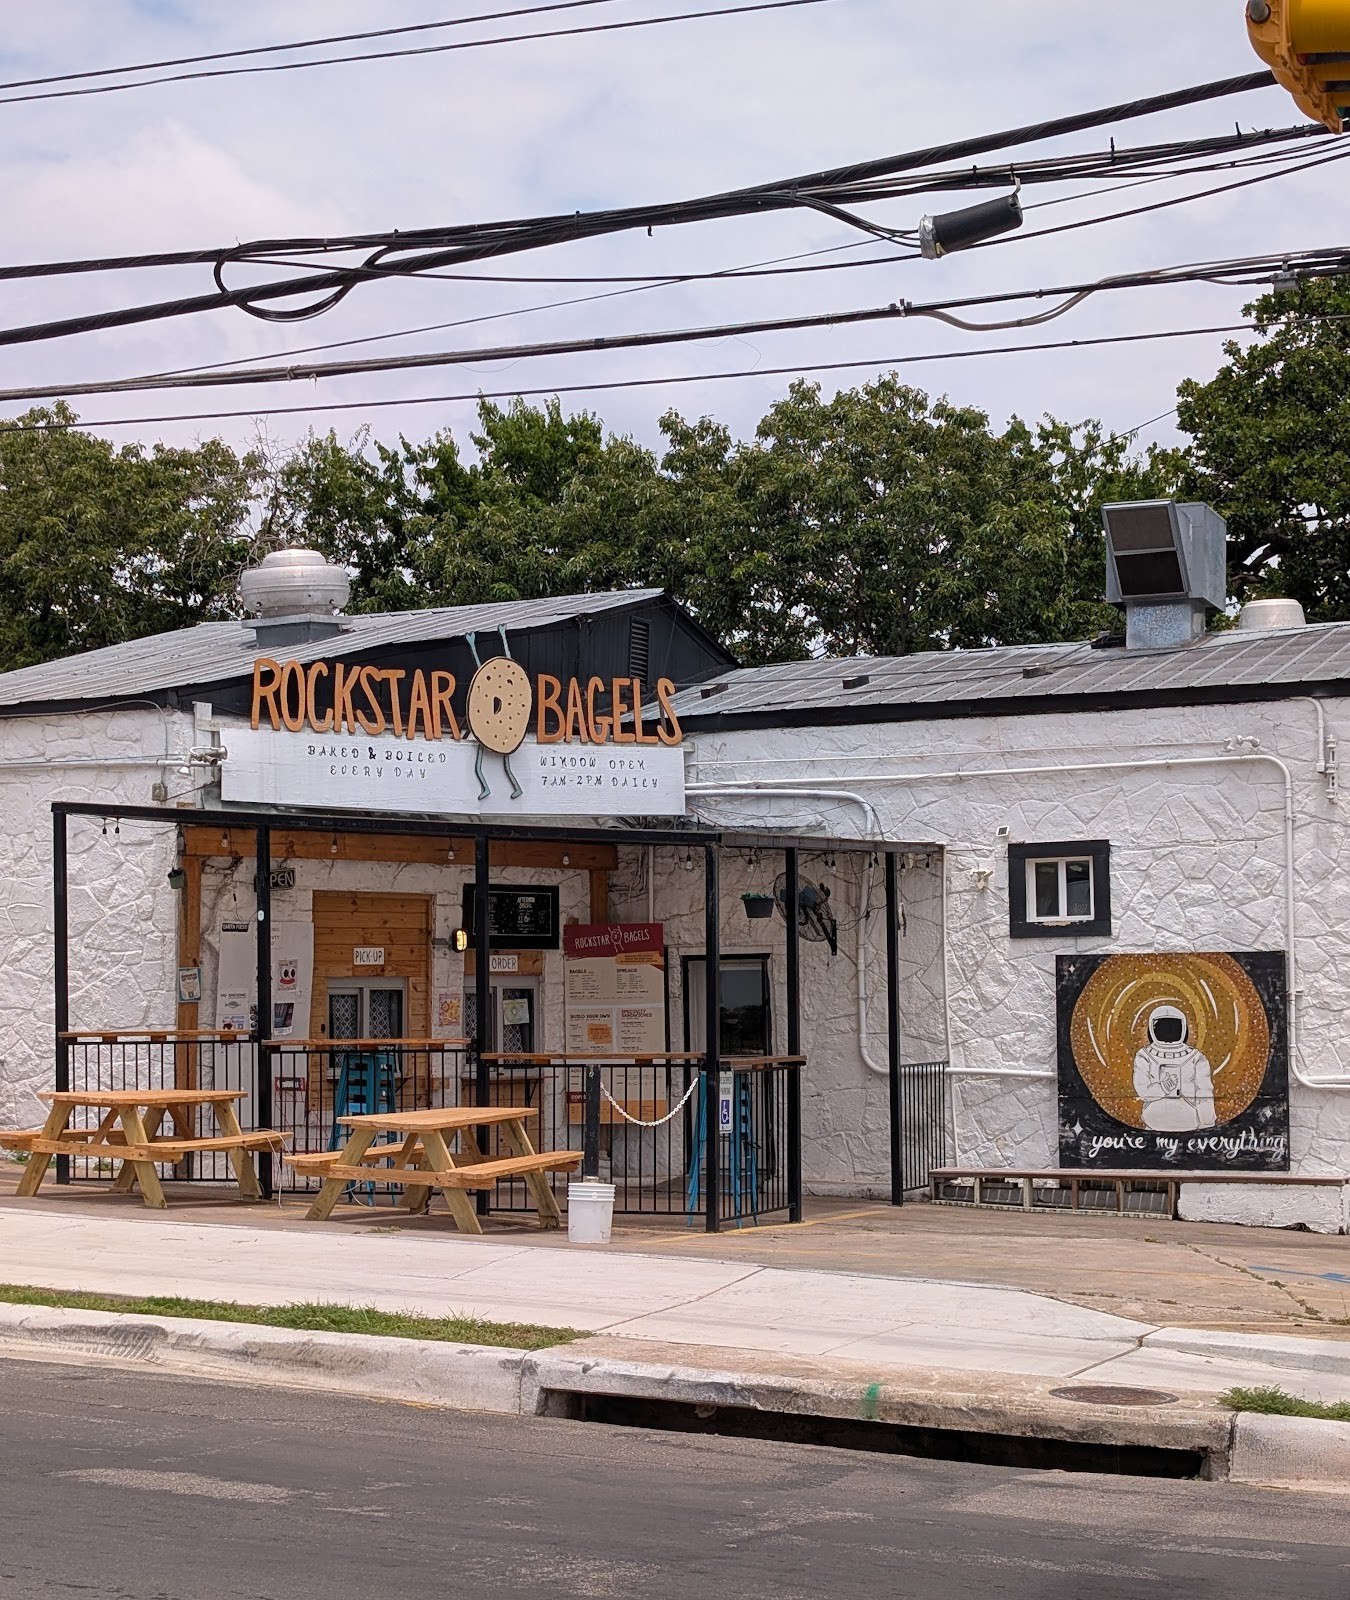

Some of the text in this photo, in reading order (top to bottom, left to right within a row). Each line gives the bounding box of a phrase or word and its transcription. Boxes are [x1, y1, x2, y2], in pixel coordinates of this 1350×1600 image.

[250, 657, 683, 745] ROCKSTAR BAGELS
[307, 745, 446, 763] BAKED & BOILED
[540, 756, 645, 770] WINDOW OPEN
[330, 765, 426, 779] EVERY DAY
[612, 777, 658, 788] DAILY
[270, 871, 294, 888] PEN
[575, 929, 650, 949] ROCKSTAR BAGELS
[355, 949, 383, 963] PICK-UP
[491, 957, 517, 970] ORDER
[1088, 1127, 1285, 1159] you're my everything
